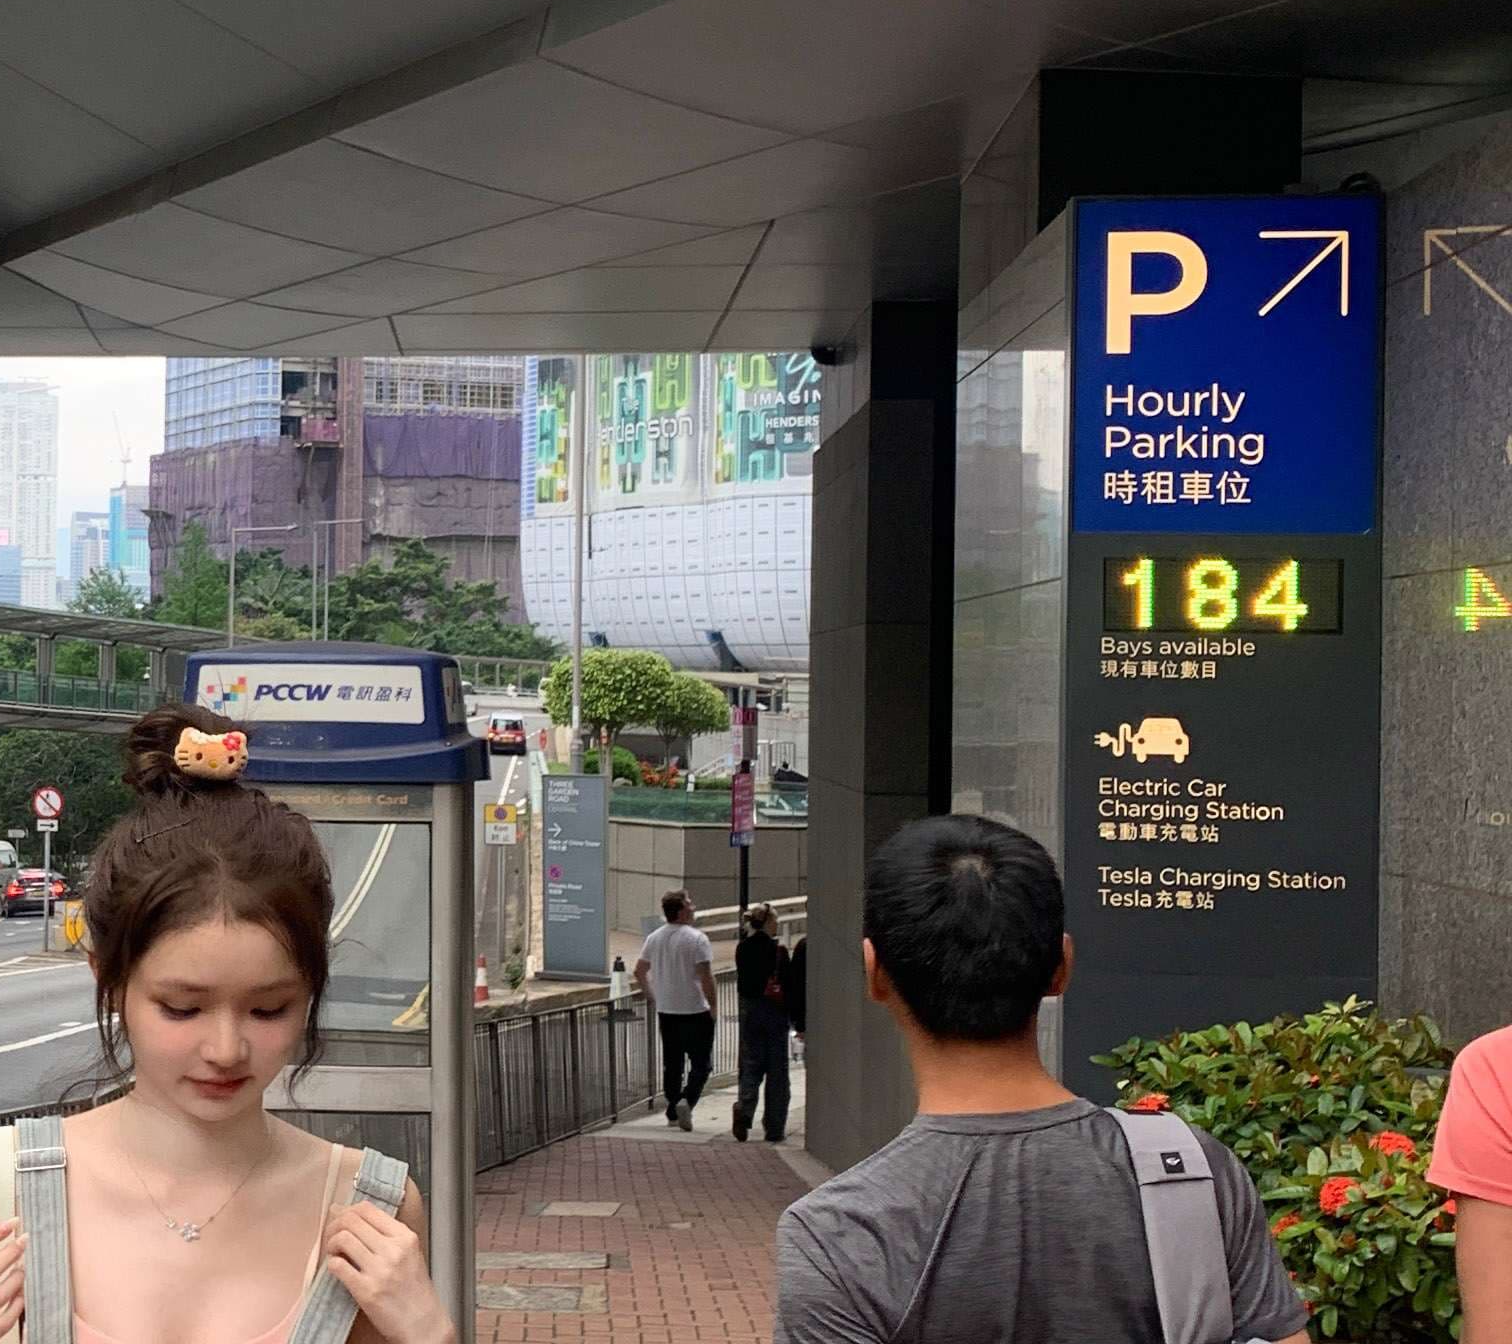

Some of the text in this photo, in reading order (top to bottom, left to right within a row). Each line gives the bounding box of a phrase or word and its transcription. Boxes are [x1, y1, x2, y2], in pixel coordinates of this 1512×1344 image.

[1106, 231, 1208, 354] P
[1104, 383, 1245, 422] Hourly
[599, 413, 693, 444] enderson
[1104, 426, 1265, 465] Parking
[1103, 470, 1251, 505] 時租車位
[1122, 557, 1308, 631] 184
[1100, 637, 1256, 657] Bays available
[1100, 660, 1217, 679] 現有車位數目
[254, 684, 413, 702] PCCW 電訊盈科
[1099, 778, 1227, 797] Electric Car
[376, 794, 408, 805] Card
[1098, 799, 1284, 821] Charging Station
[1098, 823, 1220, 843] 電動車充電站
[1098, 866, 1346, 891] Tesla Charging Station
